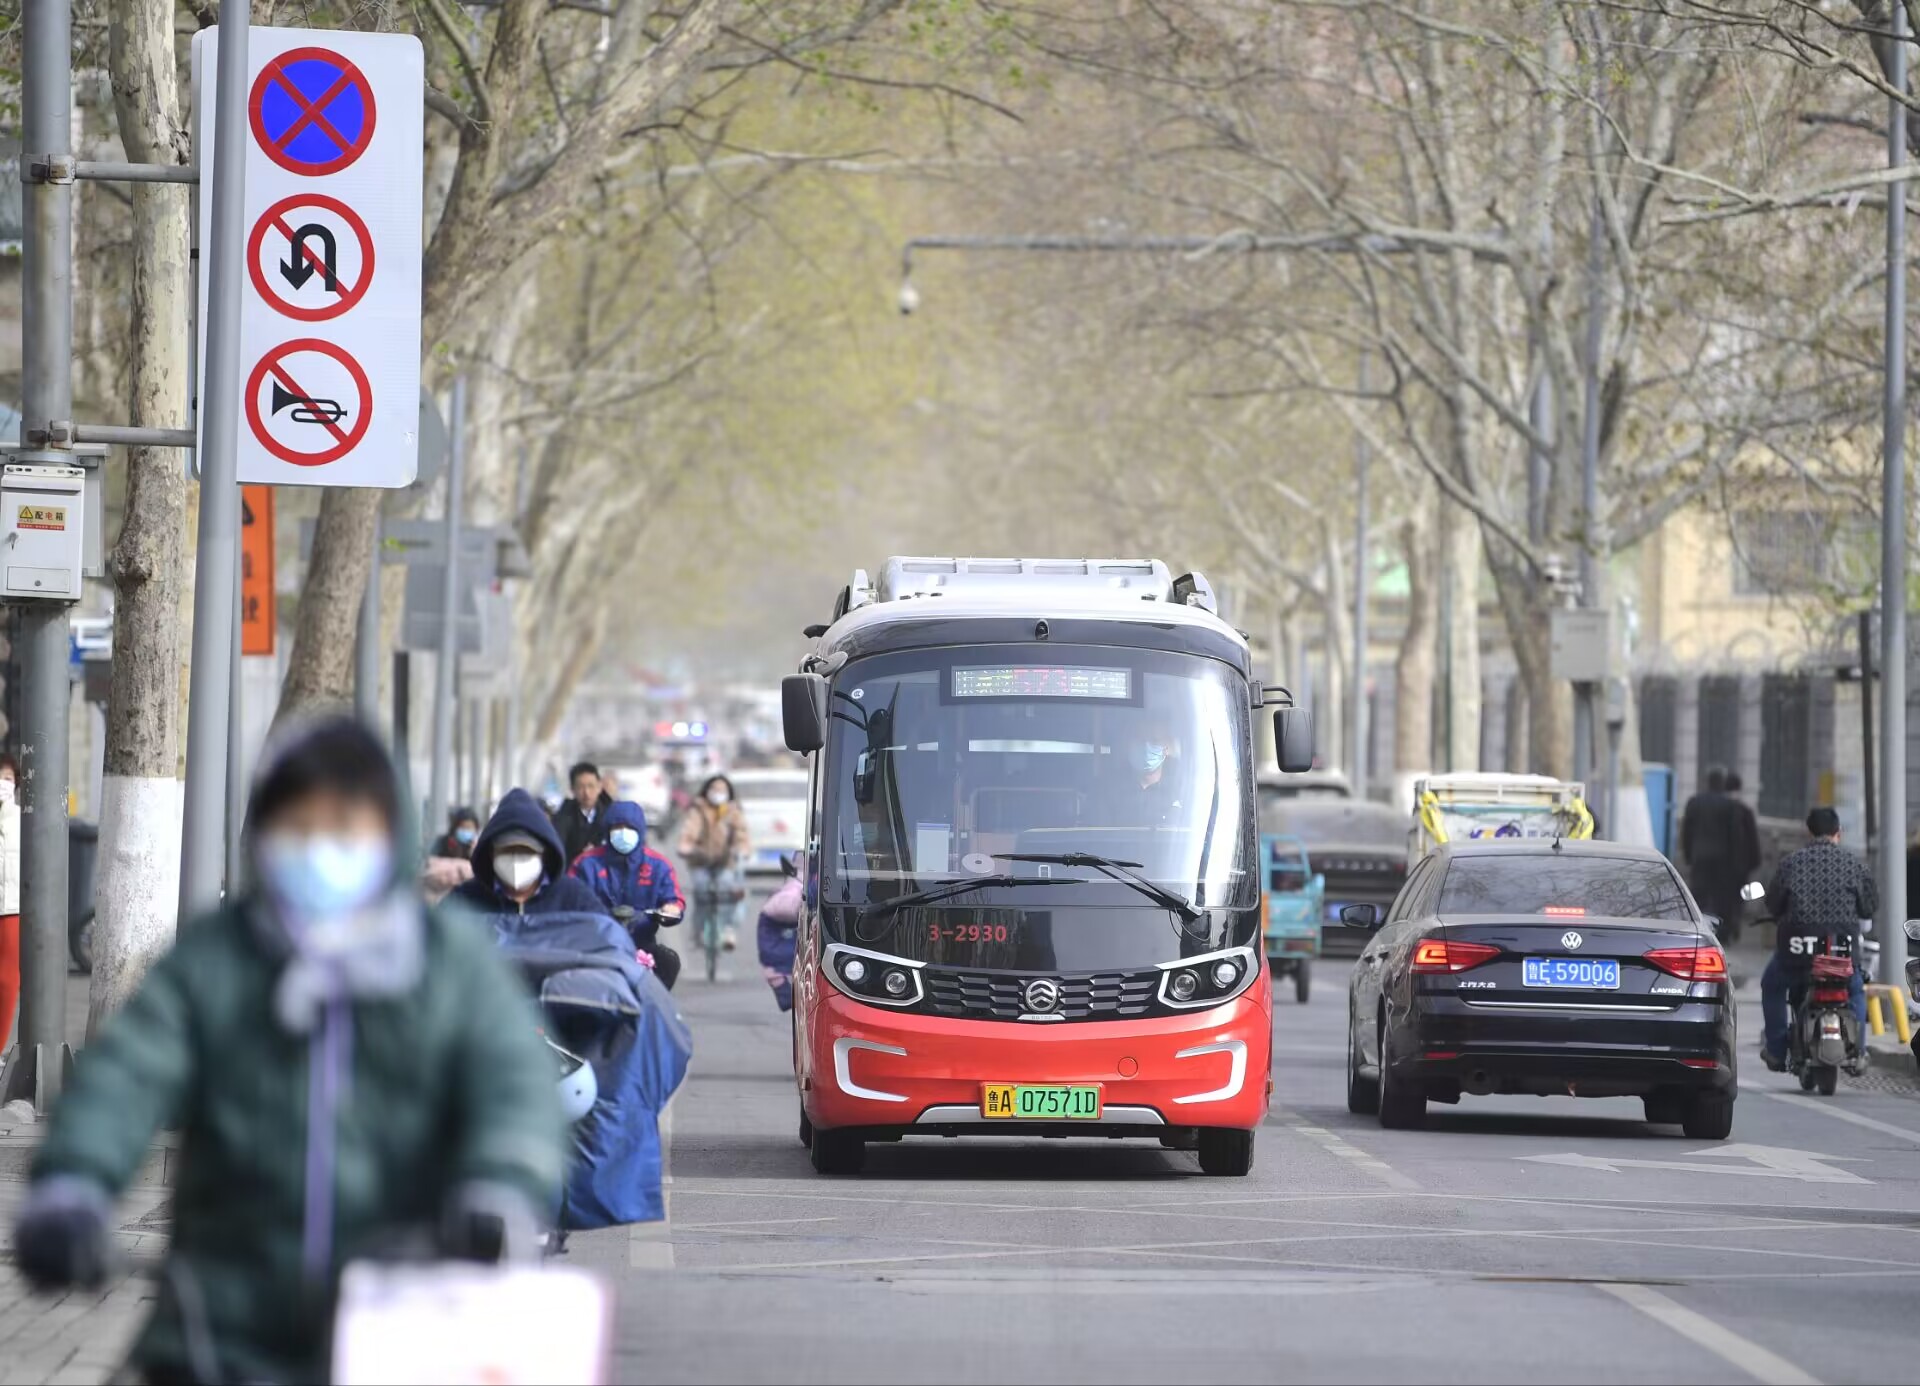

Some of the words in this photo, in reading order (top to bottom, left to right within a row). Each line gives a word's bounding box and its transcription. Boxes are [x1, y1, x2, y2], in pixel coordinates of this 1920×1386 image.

[34, 510, 64, 521] 配电箱
[928, 924, 1007, 942] 3-2930
